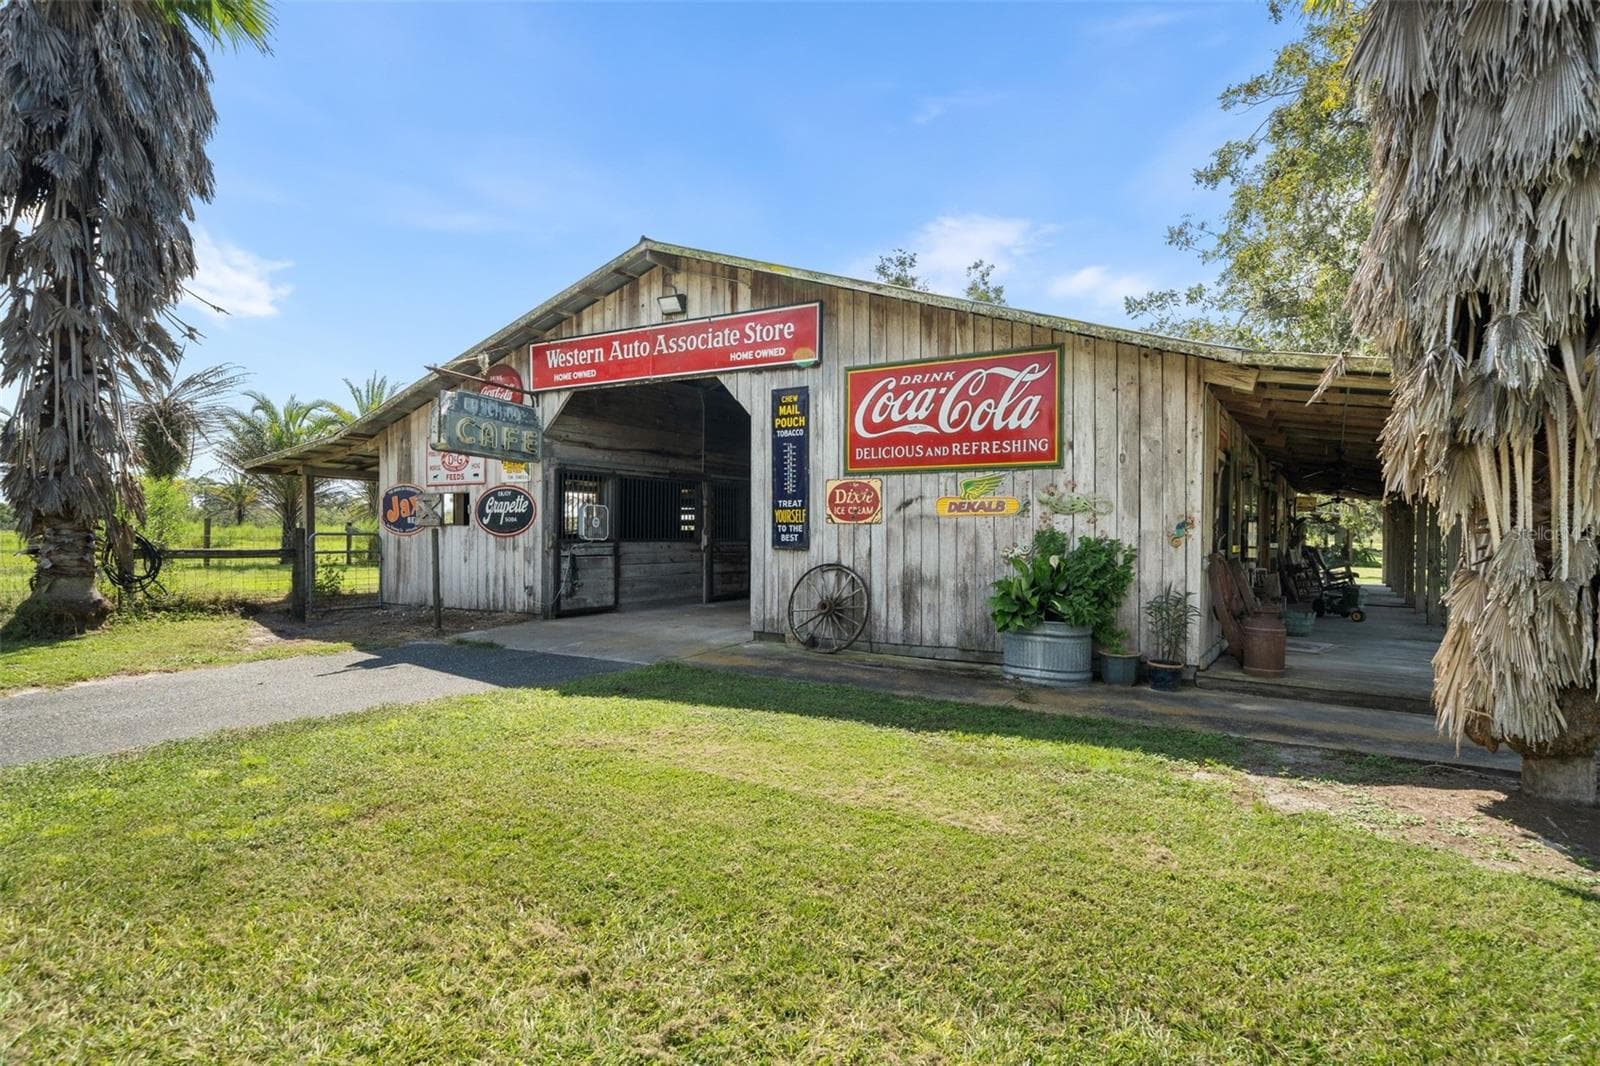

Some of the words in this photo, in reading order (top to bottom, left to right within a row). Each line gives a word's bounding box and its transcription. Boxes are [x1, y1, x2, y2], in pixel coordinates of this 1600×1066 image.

[546, 346, 605, 369] Western
[608, 340, 650, 361] Auto
[653, 327, 740, 356] Associate
[743, 319, 795, 343] Store
[730, 350, 753, 362] HOME
[754, 346, 786, 360] OWNED
[553, 371, 572, 381] HOME
[572, 369, 597, 380] OWNED
[899, 371, 957, 385] DRINK
[781, 395, 799, 403] CHEW
[854, 362, 1052, 438] Coca-Cola
[779, 404, 800, 416] MAIL
[775, 416, 806, 428] POUCH
[455, 416, 538, 454] CAFE
[776, 429, 804, 437] TOBACCO
[855, 445, 924, 460] DELICIOUS
[926, 447, 949, 457] AND
[952, 438, 1049, 455] REFRESHING
[834, 488, 874, 504] Dixie
[777, 499, 802, 508] TREAT
[947, 501, 1006, 513] DEKALB
[482, 495, 529, 525] Grapette
[774, 508, 807, 524] YOURSELF
[834, 506, 845, 515] ICE
[848, 506, 874, 515] CREAM
[777, 524, 786, 533] TO
[788, 524, 803, 533] THE
[780, 533, 799, 542] BEST
